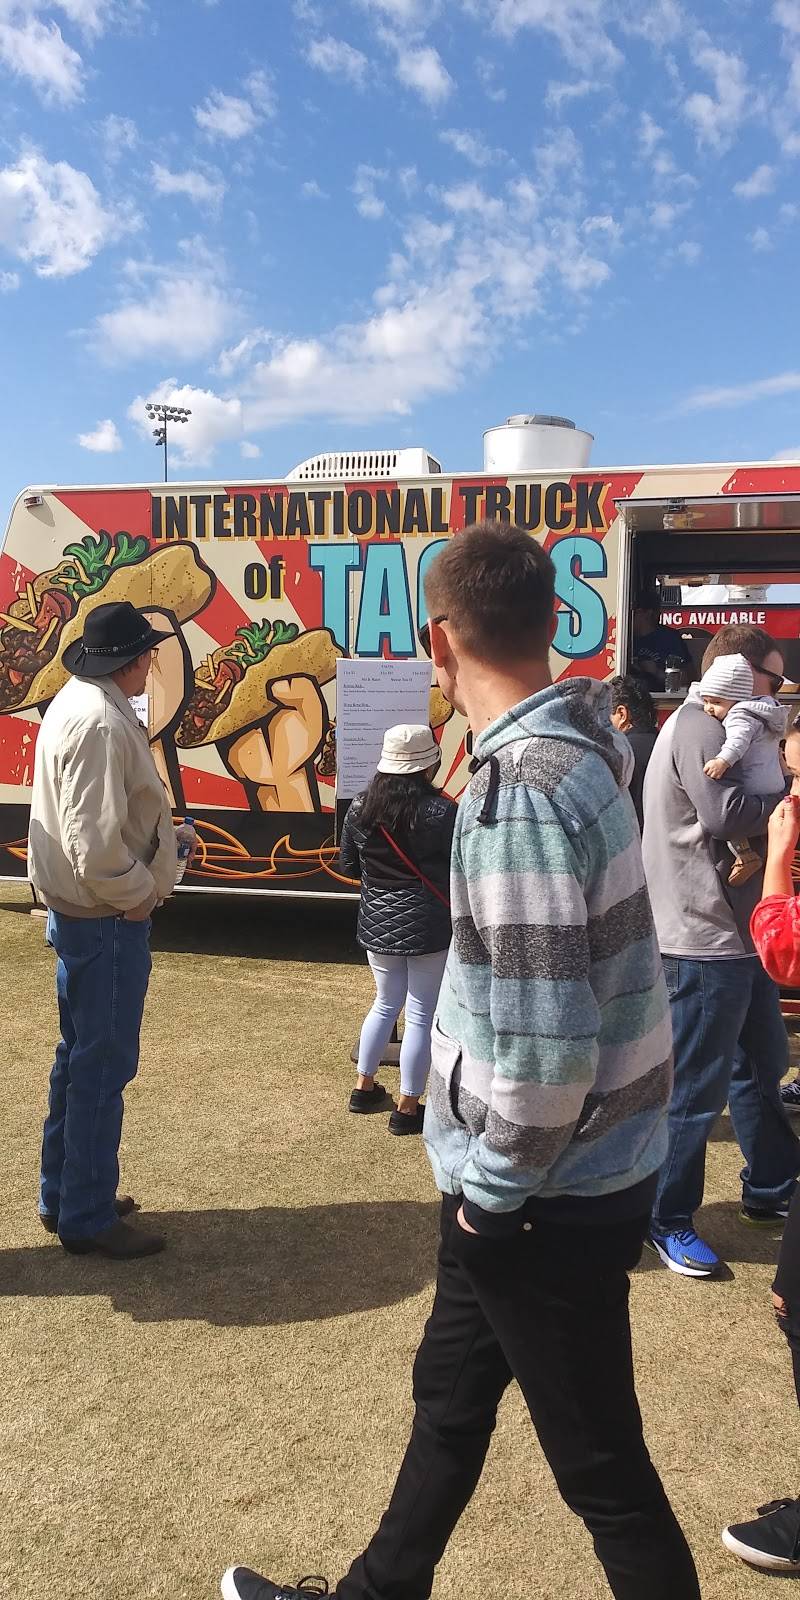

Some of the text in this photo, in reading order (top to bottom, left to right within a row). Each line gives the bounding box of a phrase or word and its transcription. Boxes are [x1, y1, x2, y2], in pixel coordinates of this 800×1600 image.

[151, 481, 607, 540] INTERNATIONAL TRUCK
[244, 555, 285, 601] of
[689, 612, 766, 625] AVAILABLE
